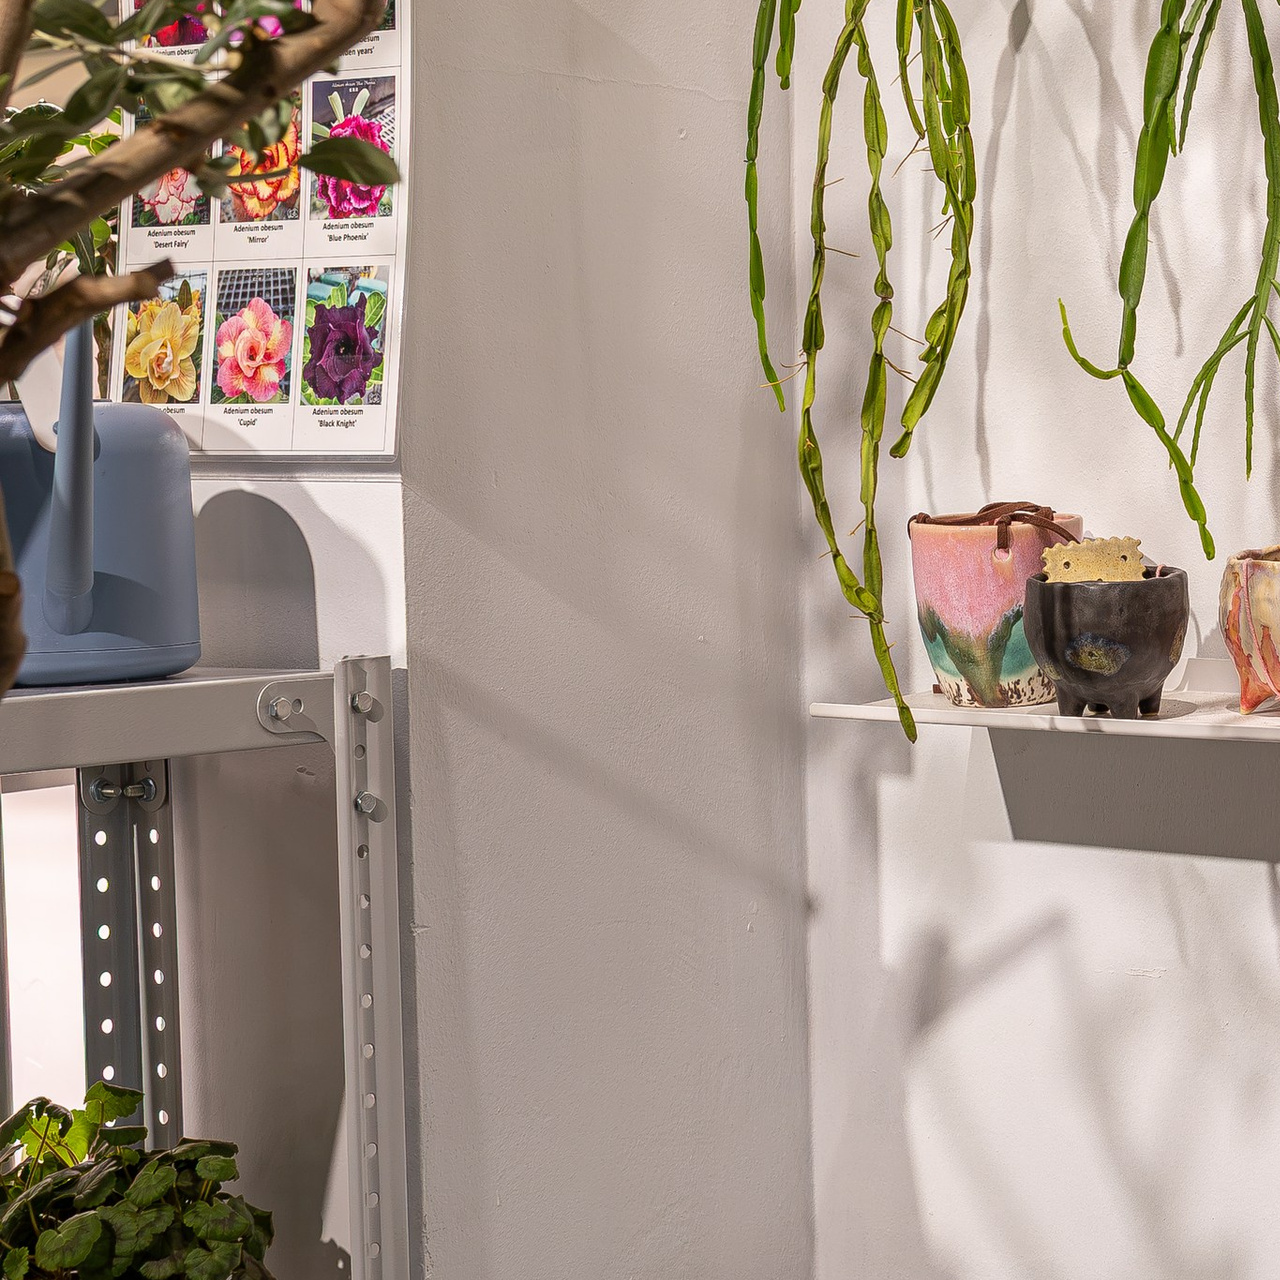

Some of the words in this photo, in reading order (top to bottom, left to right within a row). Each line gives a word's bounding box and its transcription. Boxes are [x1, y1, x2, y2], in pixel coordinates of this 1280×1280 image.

[177, 48, 200, 56] obesum
[322, 222, 350, 230] Adenium
[350, 221, 374, 229] obesum
[247, 235, 269, 244] 'Mirror'
[327, 234, 342, 242] 'Blue
[343, 233, 369, 241] Phoenix'
[174, 240, 190, 249] Fairy'
[223, 407, 250, 415] Adenium
[312, 408, 339, 416] Adenium
[340, 408, 364, 416] obesum
[237, 418, 258, 427] 'Cupid'
[318, 420, 335, 428] 'Black
[336, 420, 357, 429] Knight'
